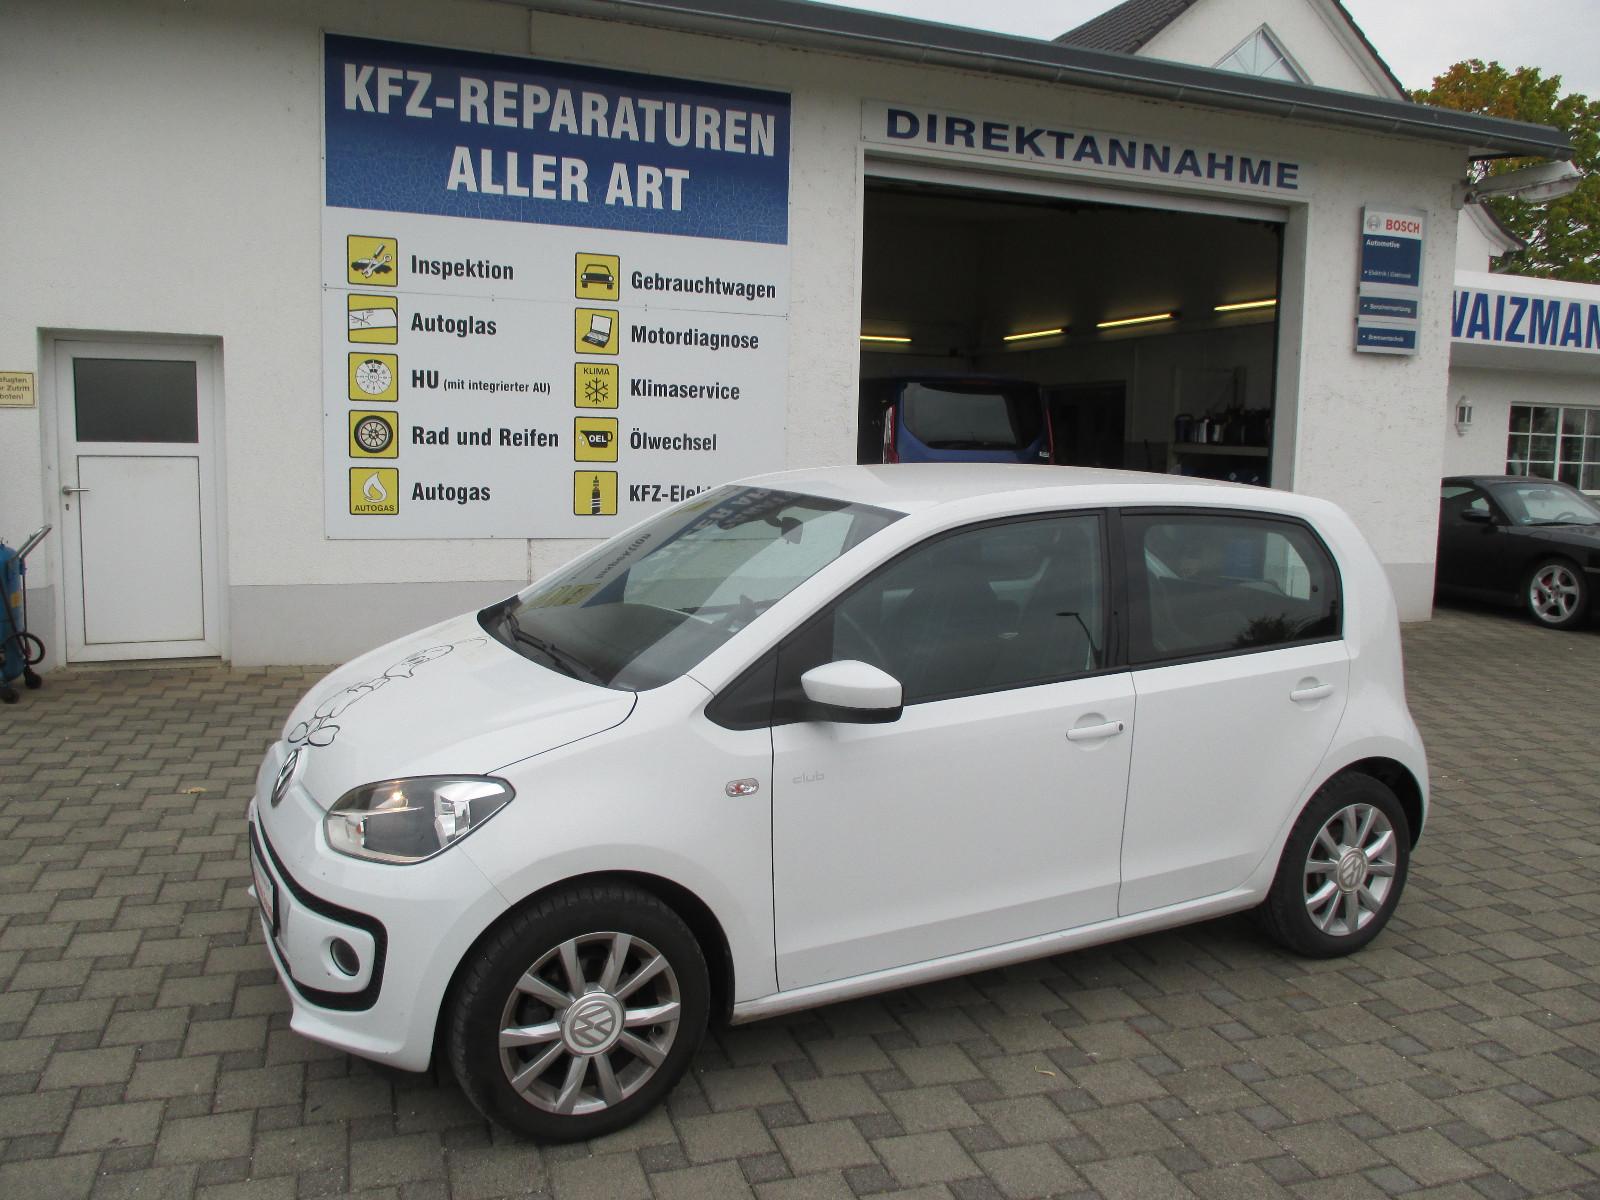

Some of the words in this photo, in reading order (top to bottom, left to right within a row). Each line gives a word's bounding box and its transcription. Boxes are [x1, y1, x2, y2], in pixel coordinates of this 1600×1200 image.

[344, 63, 776, 157] KFZ-REPARATUREN
[886, 108, 1299, 190] DIREKTANNAHME
[446, 145, 589, 203] ALLER
[605, 163, 690, 211] ART
[1385, 219, 1420, 234] BOSCH
[1366, 239, 1401, 249] Automotive
[411, 255, 514, 280] Inspektion
[631, 271, 776, 300] Gebrauchtwagen
[411, 312, 497, 338] Autoglas
[631, 325, 759, 350] Motordiagnose
[412, 370, 439, 389] HU
[444, 379, 465, 391] (mit
[468, 380, 529, 393] integrierter
[533, 382, 551, 395] AU)
[583, 367, 610, 376] KLIMA
[630, 379, 740, 400] Klimaservice
[412, 426, 449, 445] Rad
[457, 428, 492, 446] und
[500, 428, 559, 447] Reifen
[588, 434, 607, 443] OEL
[630, 428, 718, 451] Ölwechsel
[411, 482, 491, 504] Autogas
[354, 504, 395, 512] AUTOGAS
[792, 771, 825, 784] club
